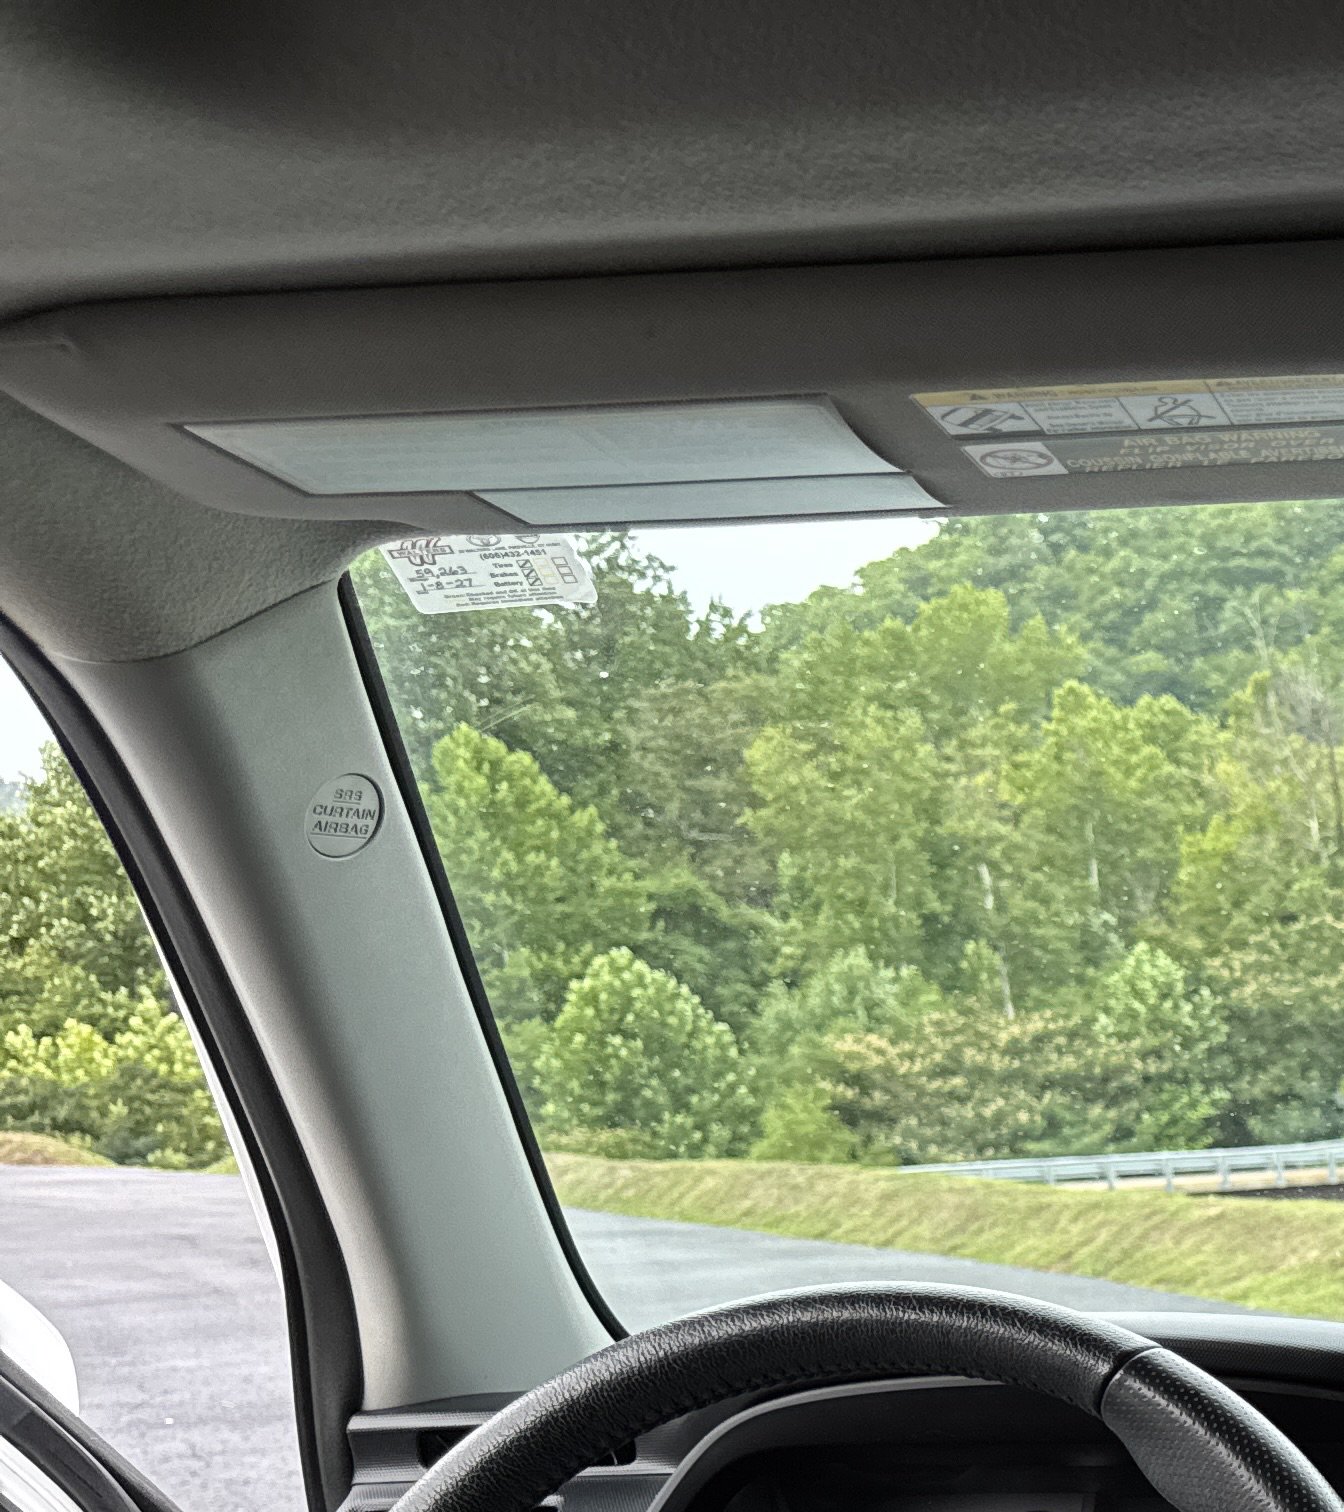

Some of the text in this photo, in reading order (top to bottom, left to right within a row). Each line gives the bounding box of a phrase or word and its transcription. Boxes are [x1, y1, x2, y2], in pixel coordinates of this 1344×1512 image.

[1123, 430, 1321, 448] AIR BAG WARNING
[1066, 455, 1143, 468] COUSSIN
[333, 788, 363, 801] SRS
[312, 804, 377, 821] CURTAIN
[312, 820, 370, 835] AIRBAG
